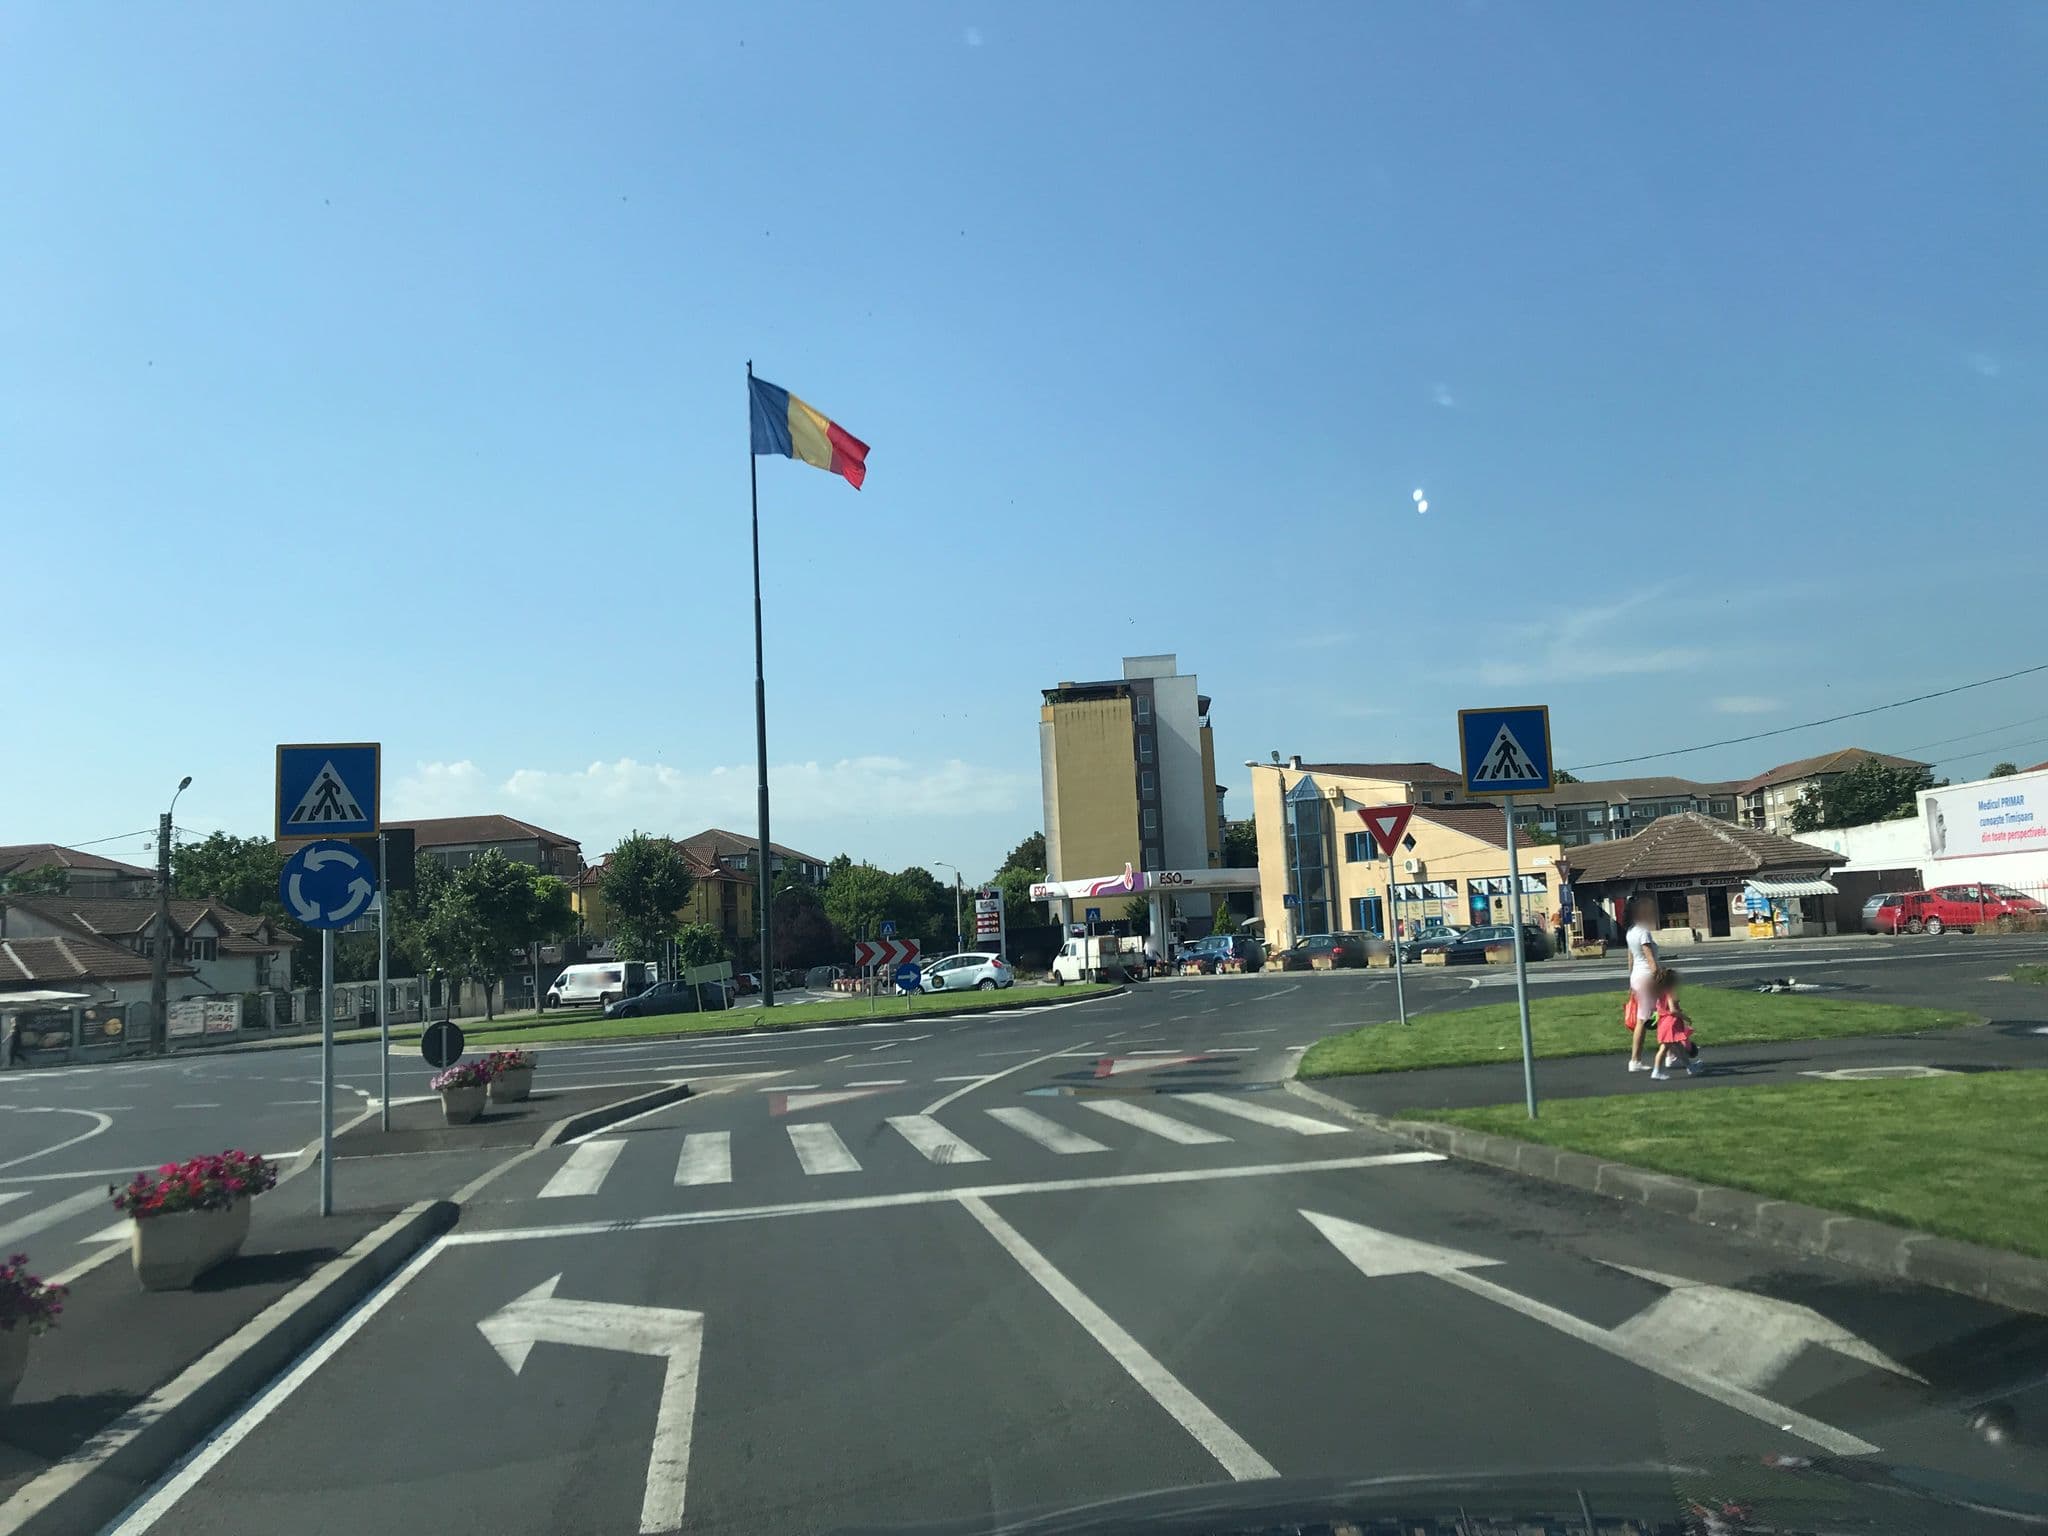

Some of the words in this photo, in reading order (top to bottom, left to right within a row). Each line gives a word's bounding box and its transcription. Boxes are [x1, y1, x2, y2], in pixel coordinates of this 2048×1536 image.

[2001, 794, 2024, 808] PRIMAR
[1160, 872, 1182, 885] ESO
[1034, 886, 1046, 896] ESO
